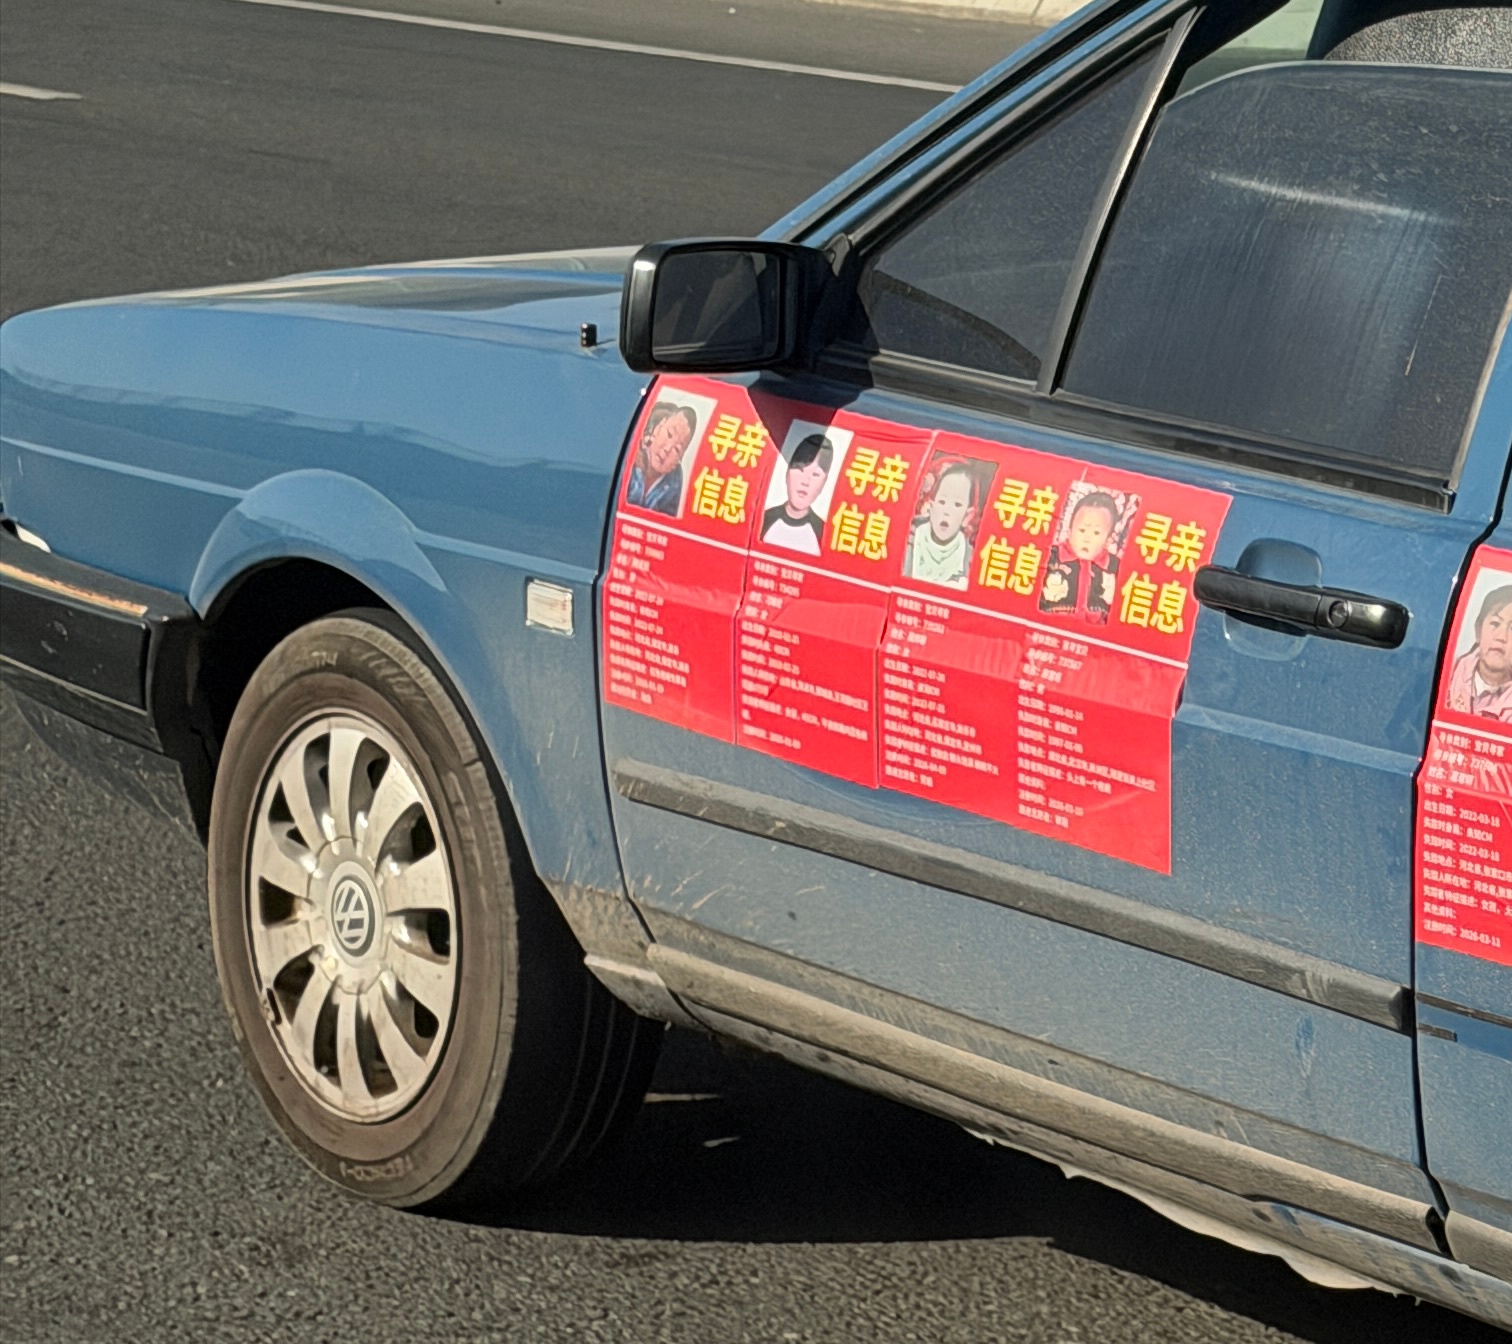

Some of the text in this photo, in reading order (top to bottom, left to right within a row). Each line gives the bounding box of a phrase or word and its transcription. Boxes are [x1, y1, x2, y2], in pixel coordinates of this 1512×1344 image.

[707, 413, 768, 468] 寻亲
[691, 466, 749, 524] 信息
[844, 446, 908, 503] 寻亲
[829, 500, 891, 561] 信息
[992, 478, 1058, 536] 寻亲
[977, 535, 1044, 596] 信息
[1134, 511, 1205, 573] 寻亲
[1119, 571, 1188, 634] 信息
